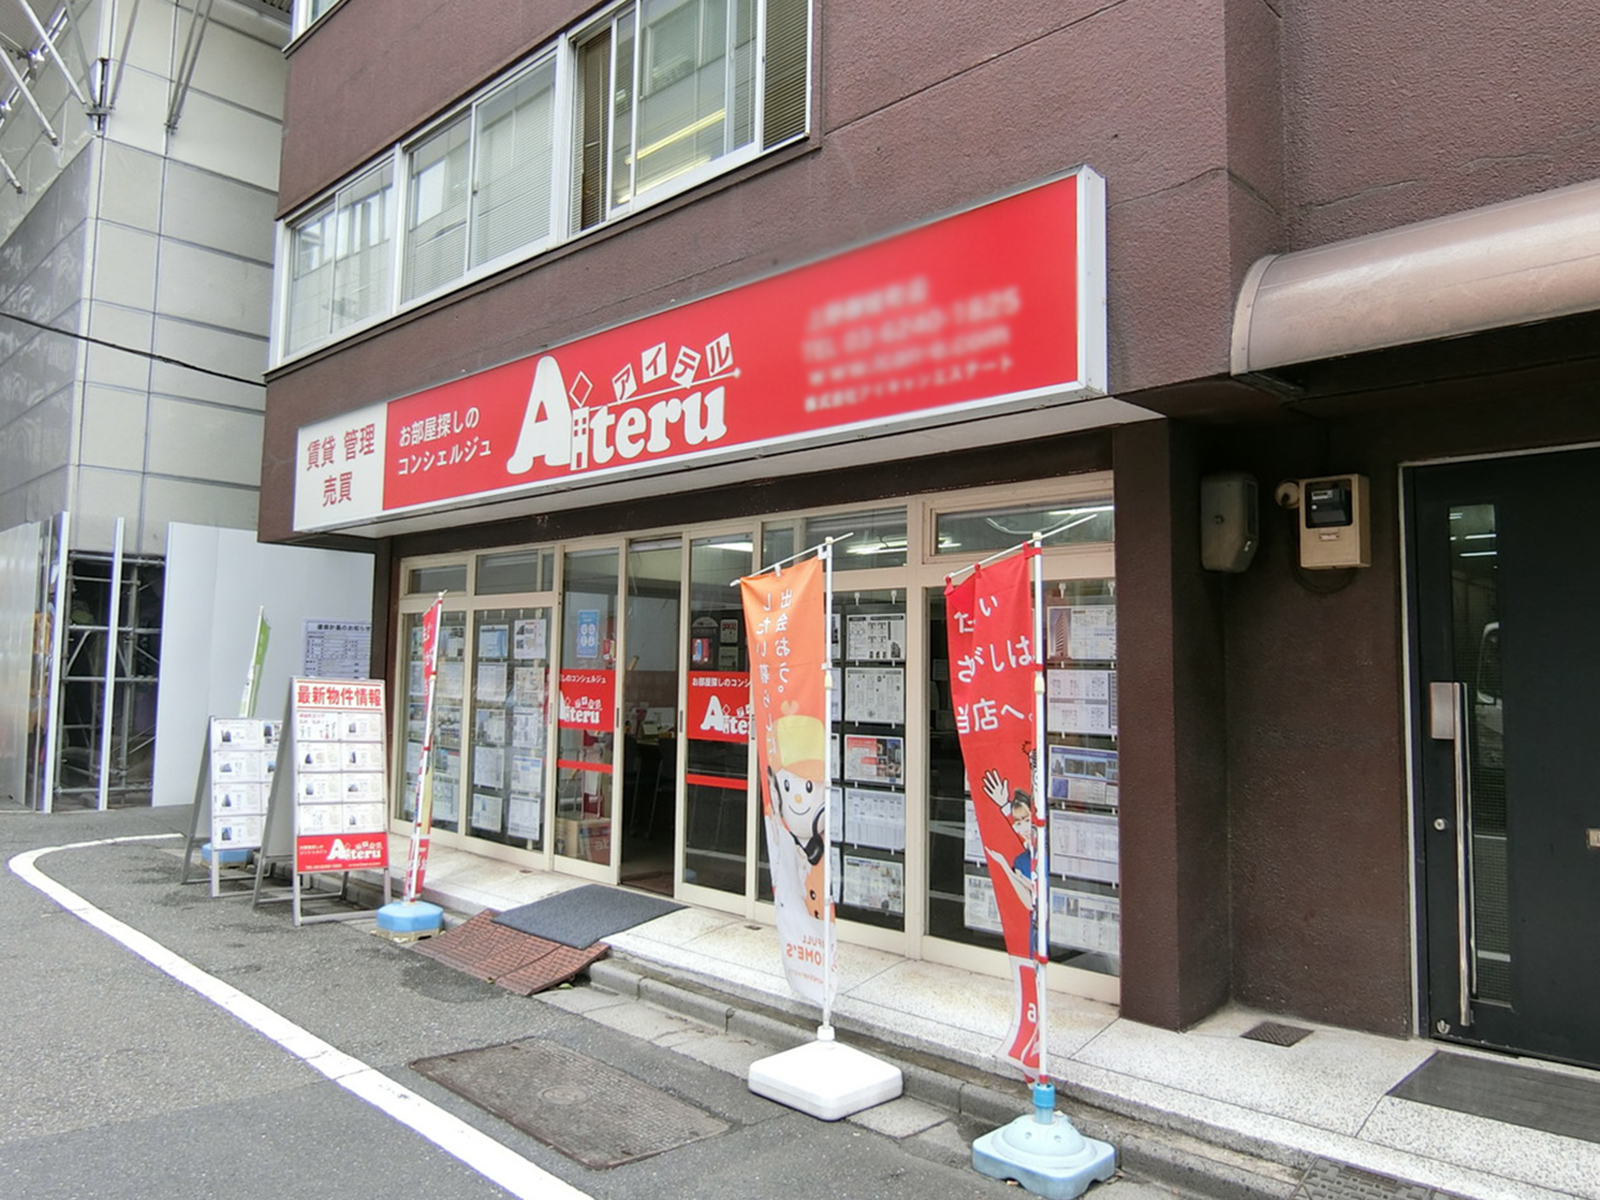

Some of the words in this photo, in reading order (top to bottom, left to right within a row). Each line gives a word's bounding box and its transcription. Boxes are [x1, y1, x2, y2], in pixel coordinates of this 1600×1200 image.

[613, 334, 733, 404] アイテル
[399, 407, 480, 447] お部屋探しの
[507, 356, 727, 474] Aiteru
[307, 435, 336, 471] 賃貸
[343, 423, 375, 461] 管理
[398, 436, 491, 475] コンシェルジュ
[323, 471, 352, 507] 売買
[297, 685, 382, 706] 最新物件情報
